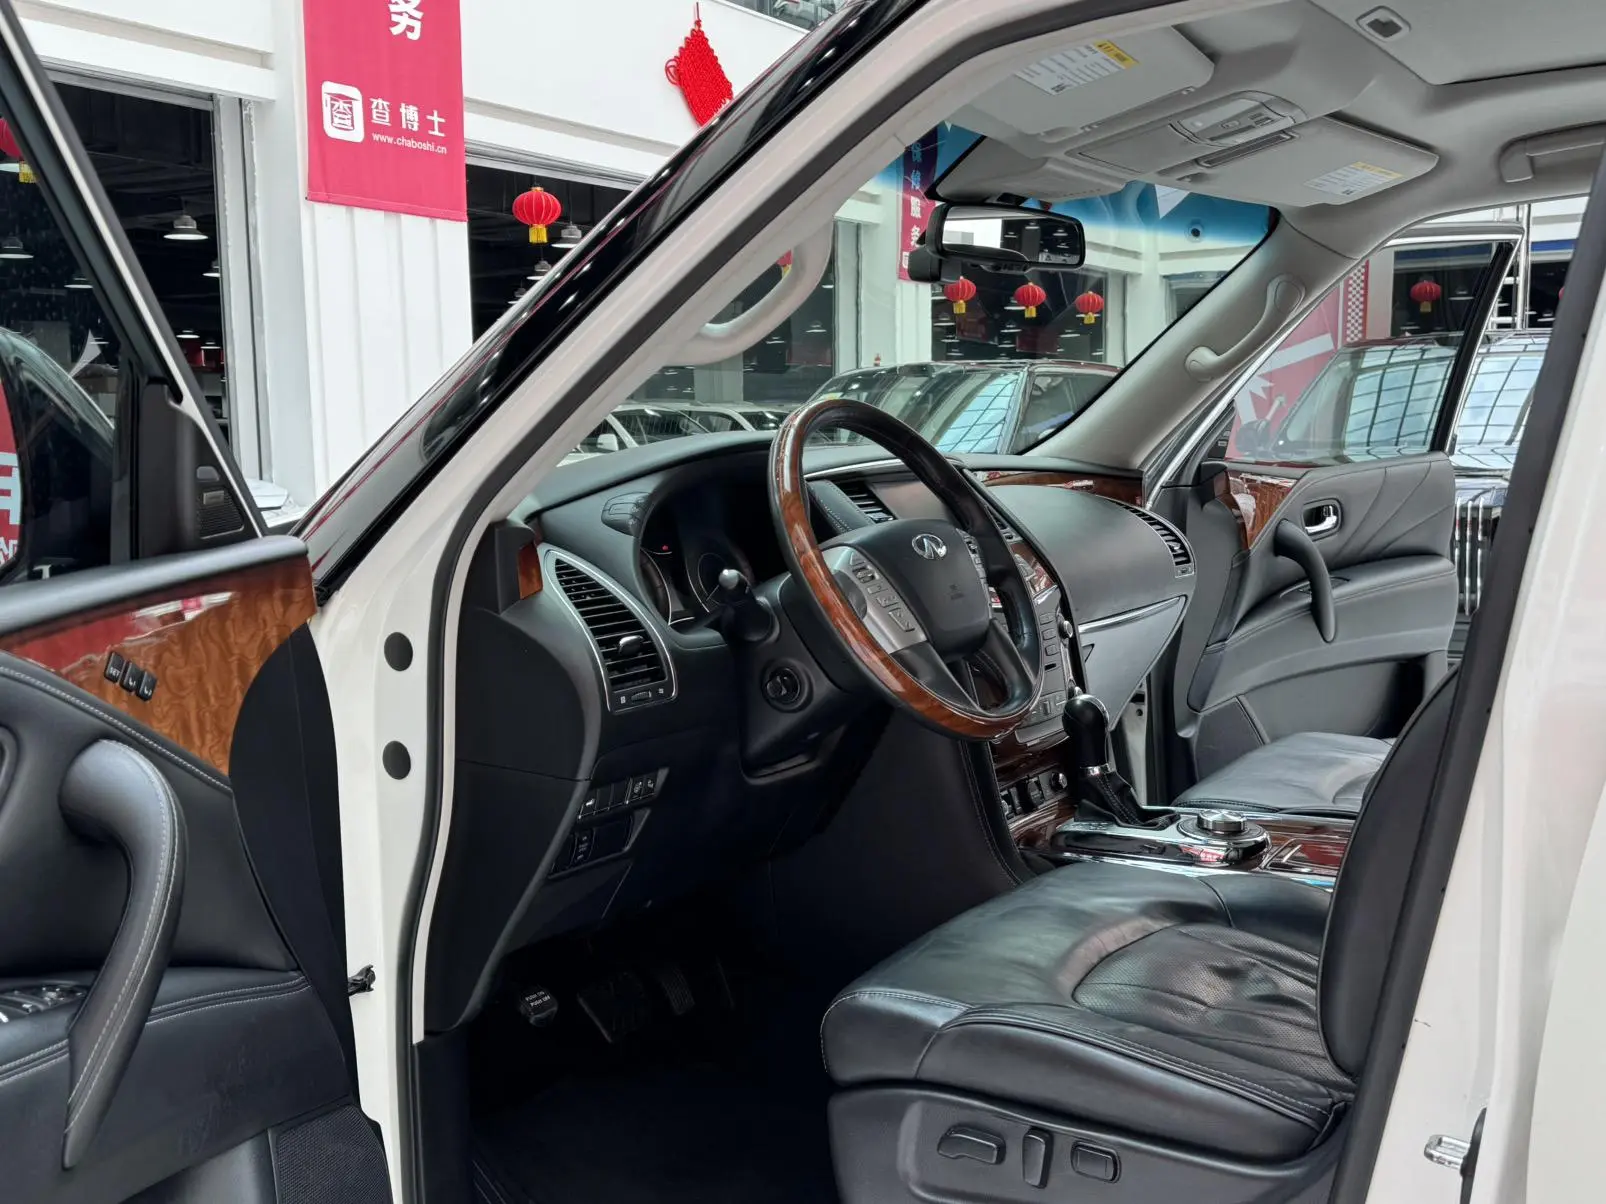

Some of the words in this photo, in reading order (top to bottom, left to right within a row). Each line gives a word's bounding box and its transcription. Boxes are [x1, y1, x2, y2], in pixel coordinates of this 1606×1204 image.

[370, 97, 445, 137] 查博士
[372, 131, 447, 155] www.chaboshi.cn
